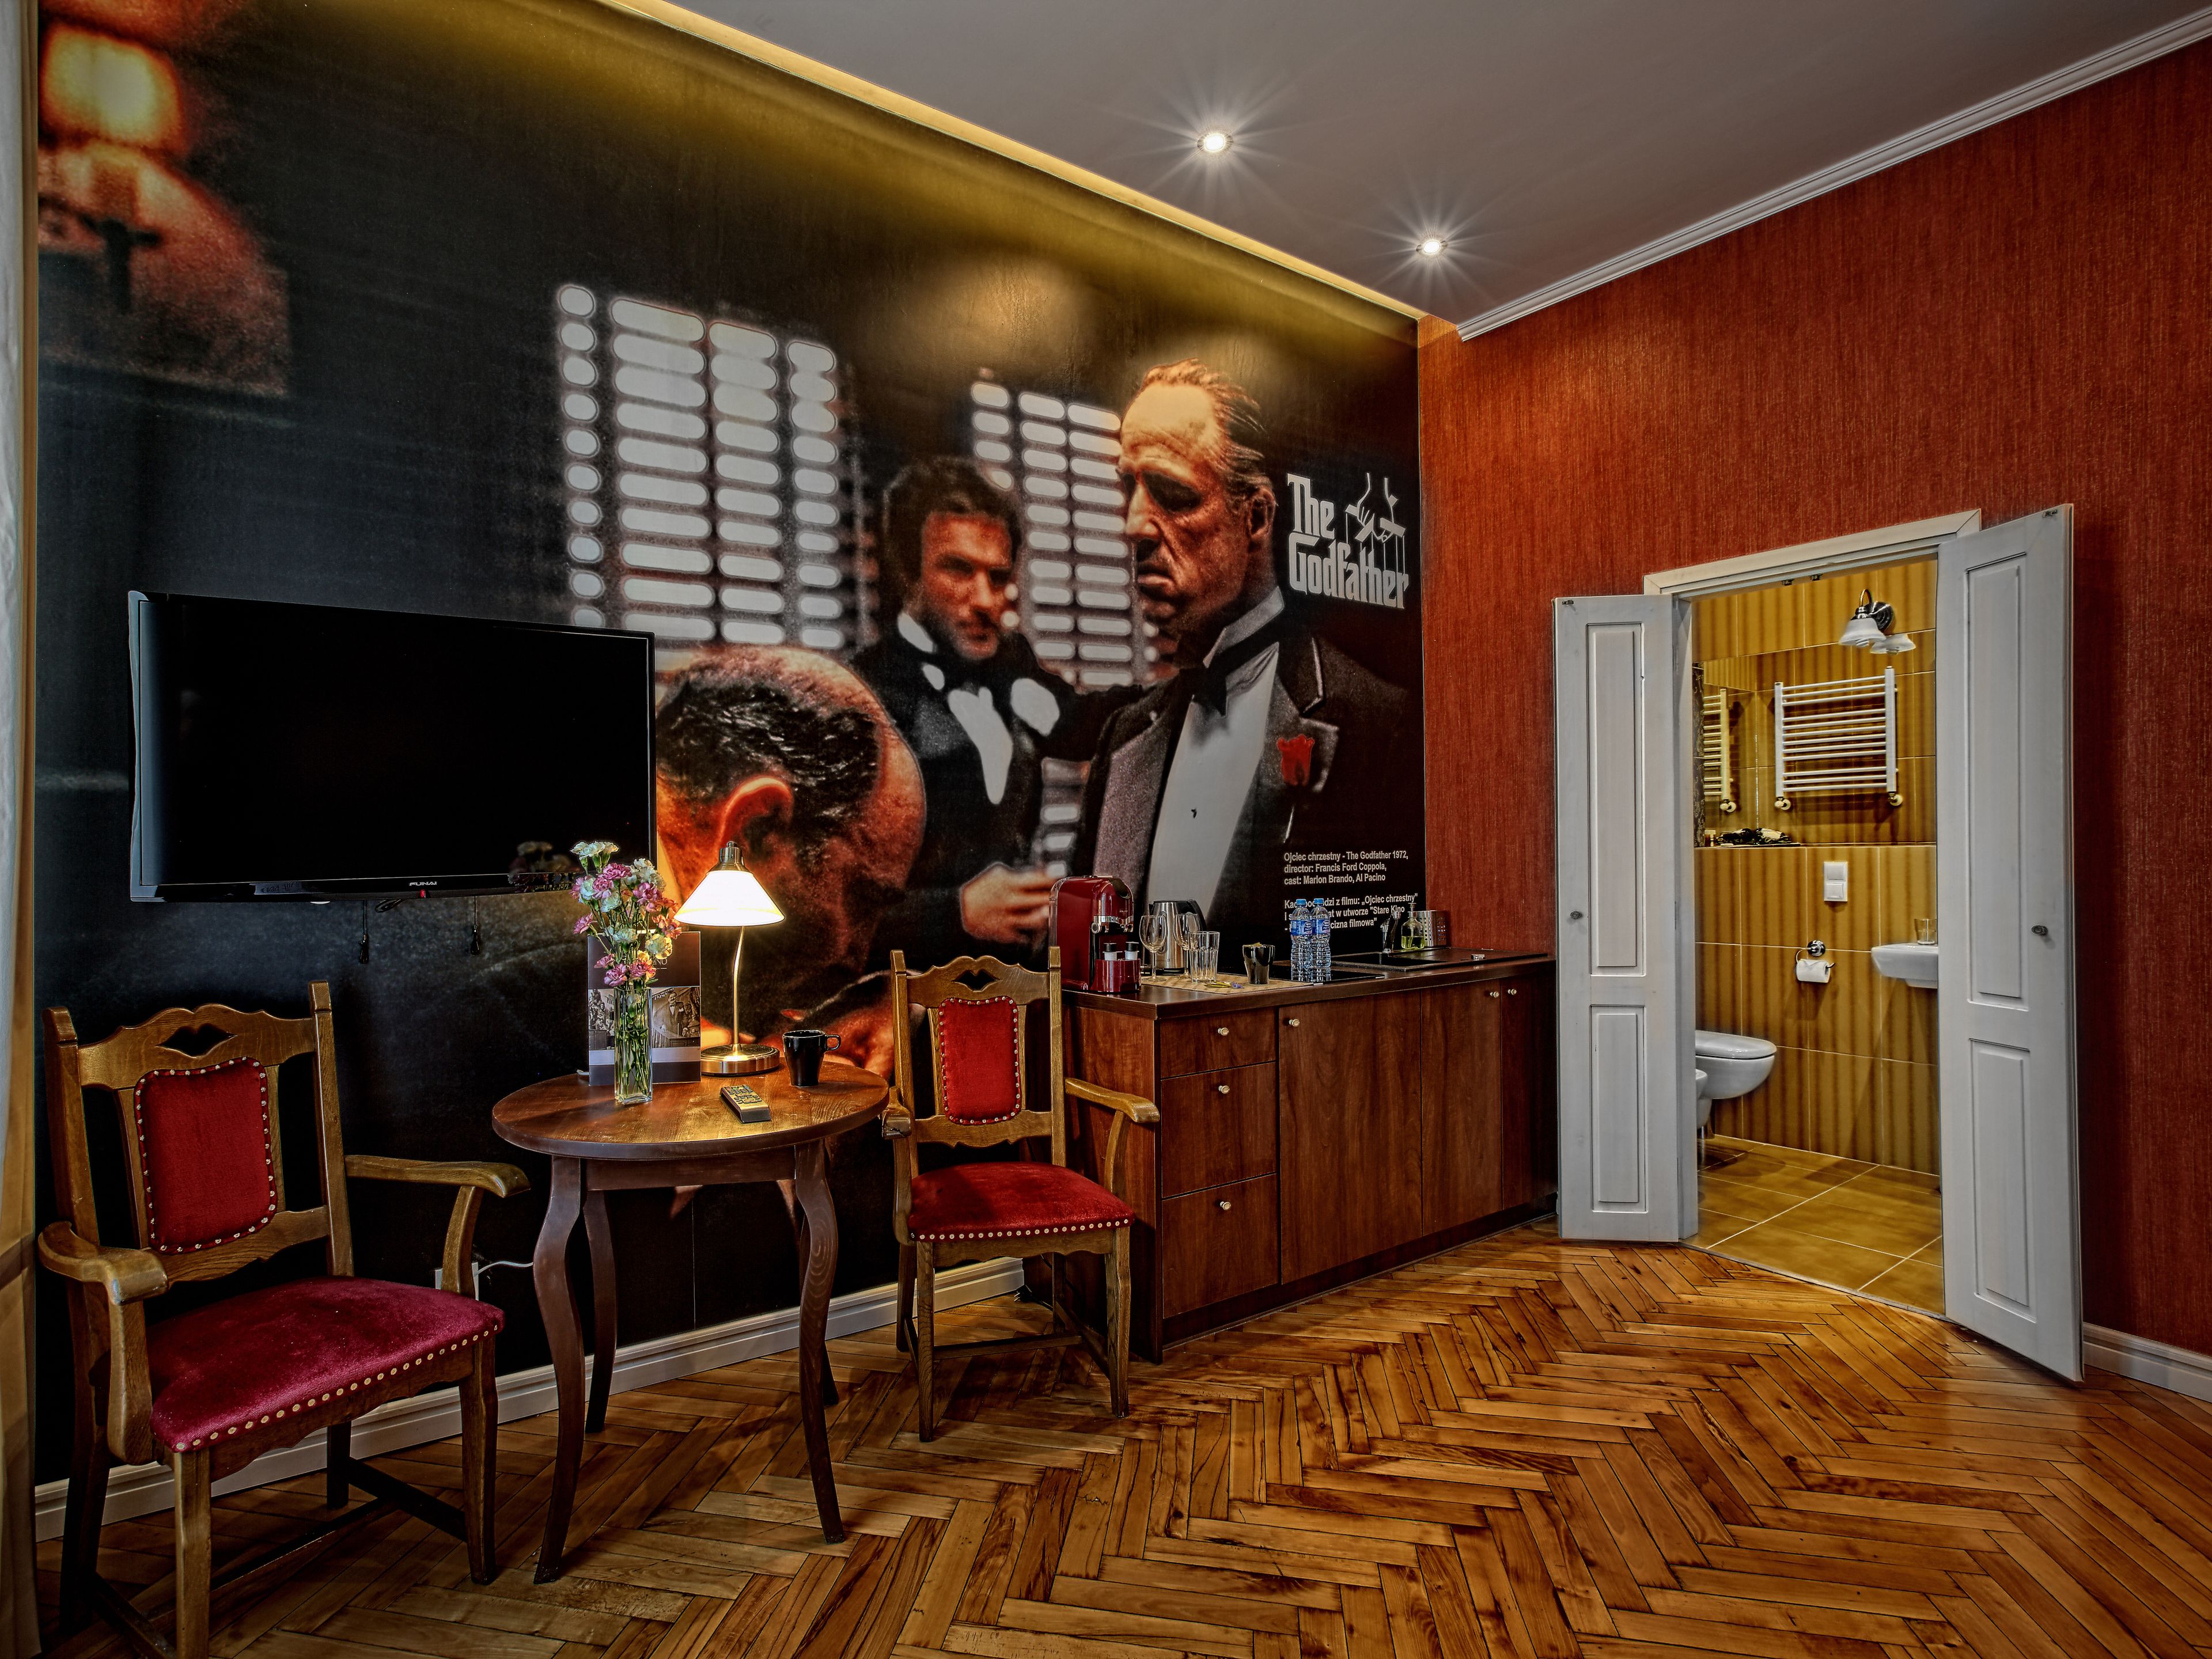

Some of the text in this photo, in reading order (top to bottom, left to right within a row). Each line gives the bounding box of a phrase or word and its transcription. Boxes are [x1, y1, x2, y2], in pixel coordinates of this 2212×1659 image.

[1287, 473, 1335, 540] The
[1289, 532, 1409, 609] Godfather
[1284, 852, 1306, 863] Ojciec
[1308, 851, 1341, 862] chrzestny
[1346, 851, 1358, 860] The
[1360, 851, 1391, 859] Godfather
[1392, 850, 1408, 859] 1972,
[1284, 861, 1387, 873] director: Francis Ford Coppola,
[1284, 873, 1386, 885] cast: Marlon Brando, Al Pacino
[1342, 896, 1360, 906] filmu:
[1343, 908, 1369, 917] utworze
[1391, 905, 1405, 914] Kino
